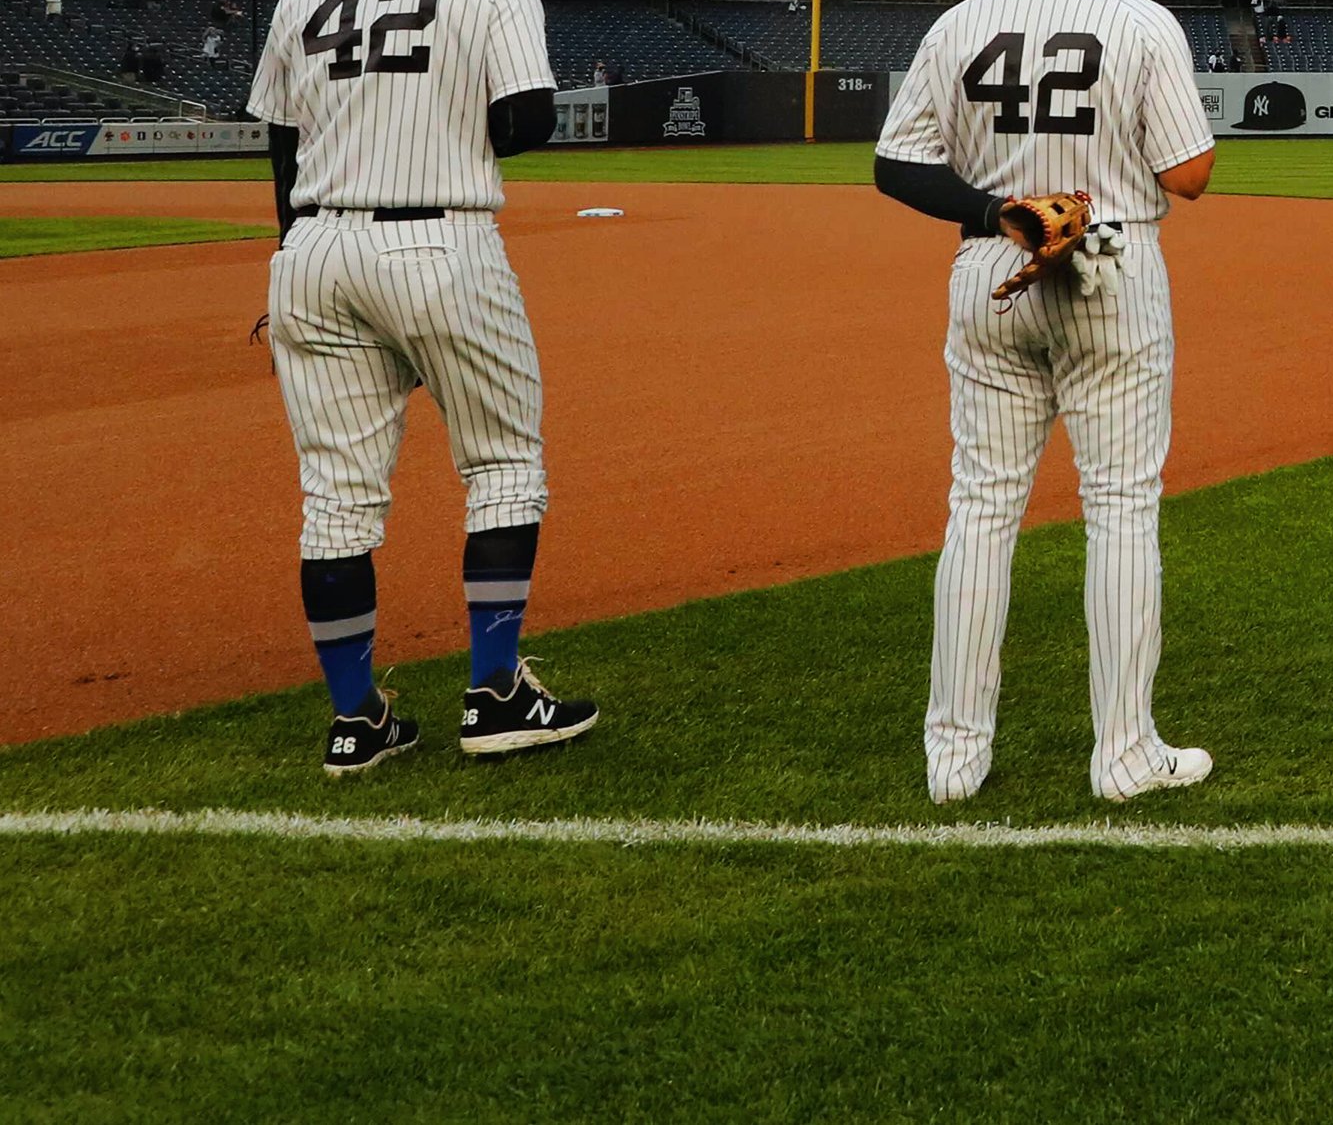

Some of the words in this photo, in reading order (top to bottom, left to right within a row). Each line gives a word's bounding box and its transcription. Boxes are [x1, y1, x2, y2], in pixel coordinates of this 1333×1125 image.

[961, 33, 1104, 135] 42
[1202, 104, 1220, 113] RA
[26, 130, 86, 147] ACC
[332, 736, 356, 754] 26
